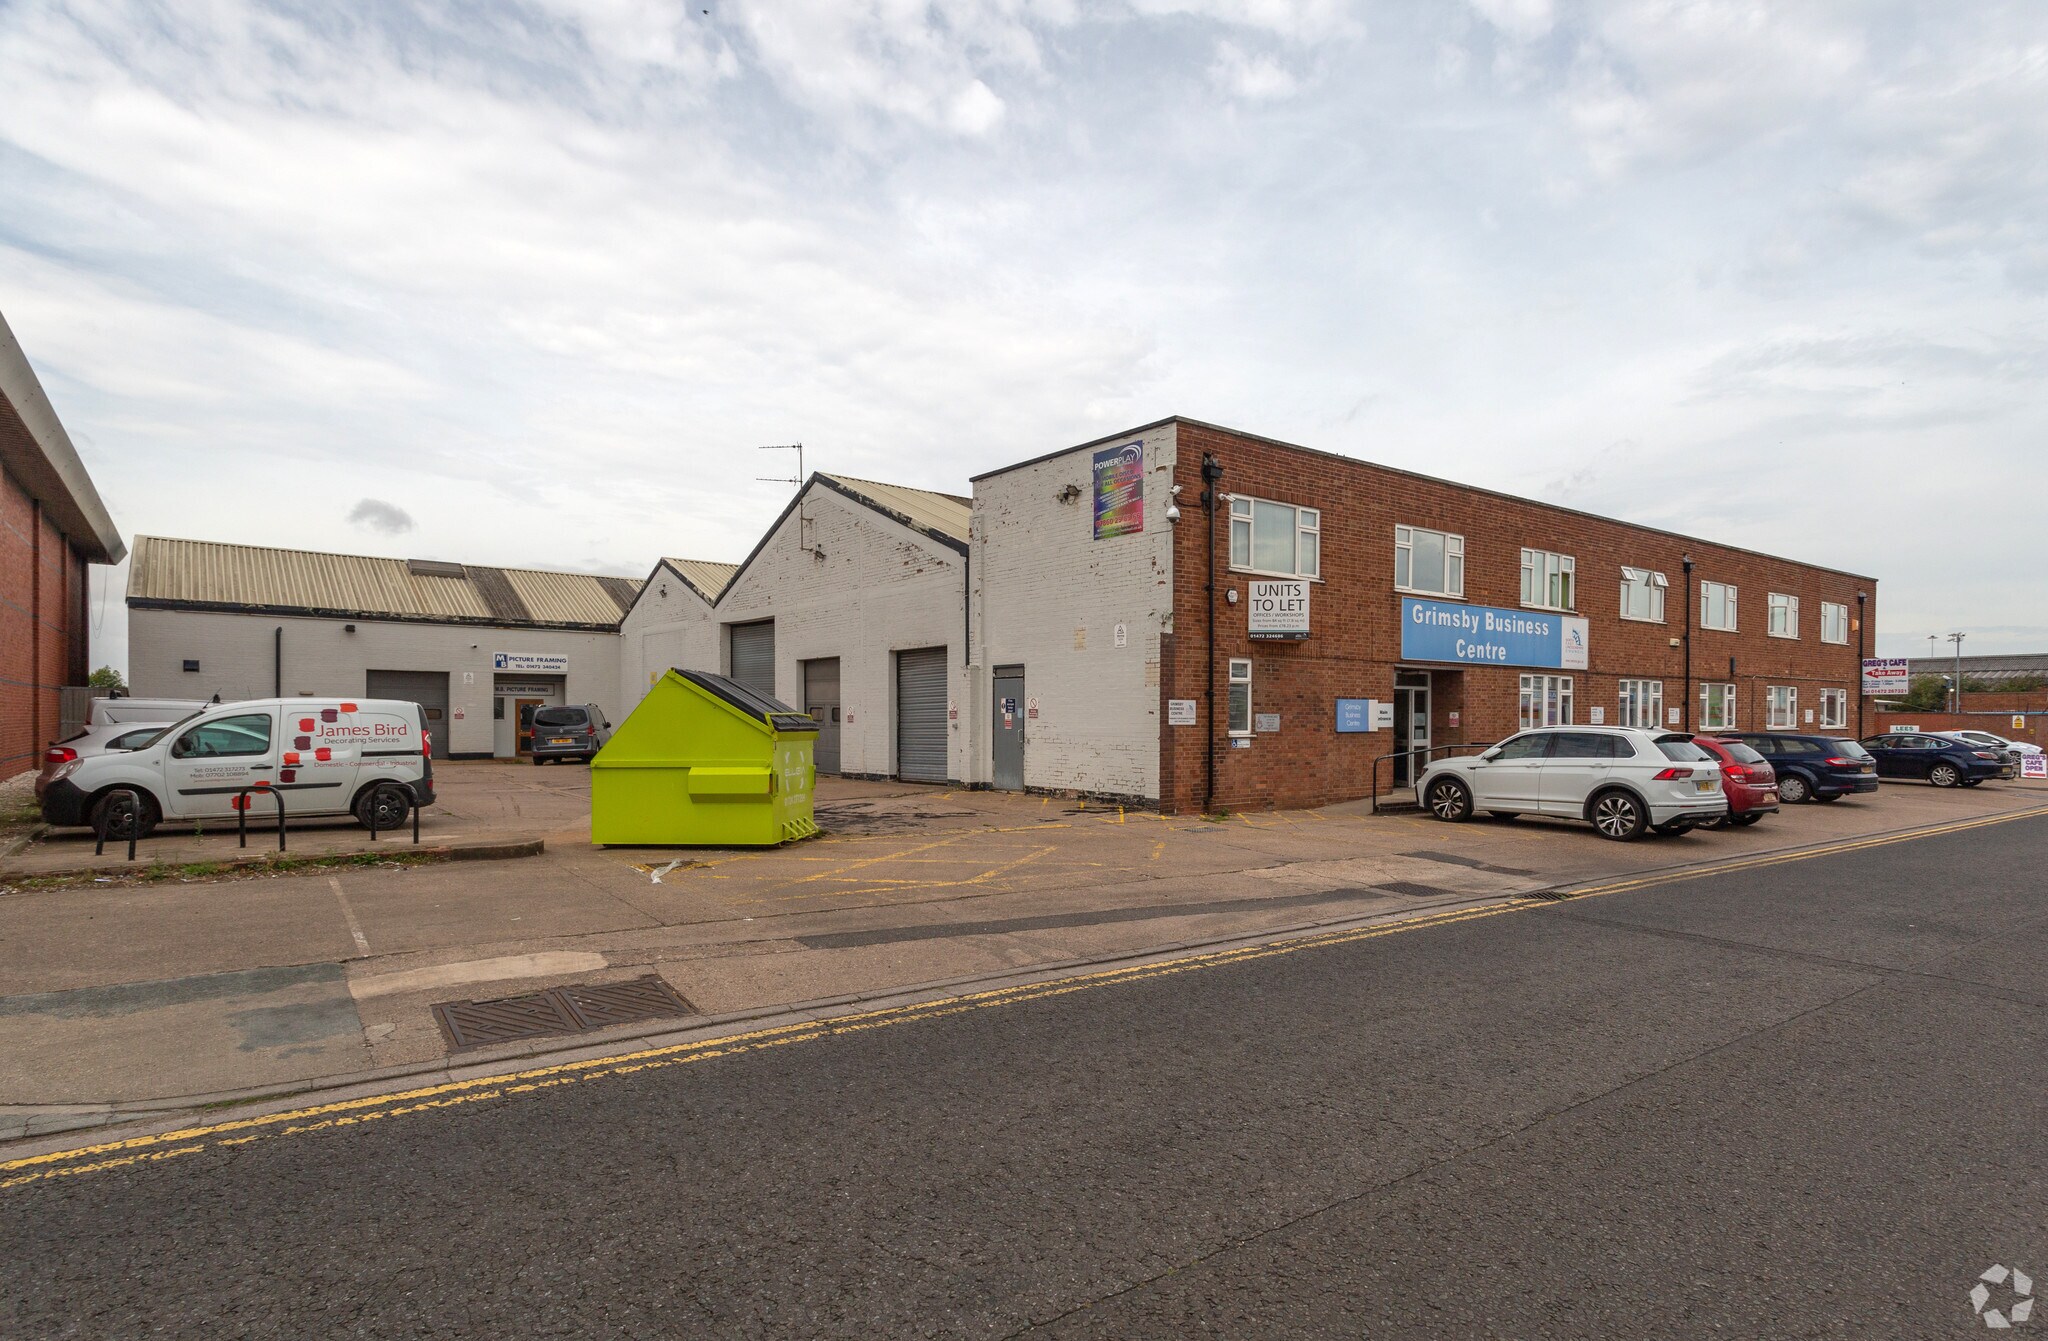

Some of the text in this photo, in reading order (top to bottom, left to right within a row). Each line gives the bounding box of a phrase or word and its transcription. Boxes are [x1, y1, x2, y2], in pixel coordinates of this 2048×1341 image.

[1094, 453, 1136, 470] POWERPLAY
[1258, 584, 1302, 596] UNITS
[1252, 599, 1305, 612] TO LET
[1412, 604, 1549, 636] Grimsby Business
[1456, 638, 1506, 660] Centre
[316, 724, 407, 738] James Bird
